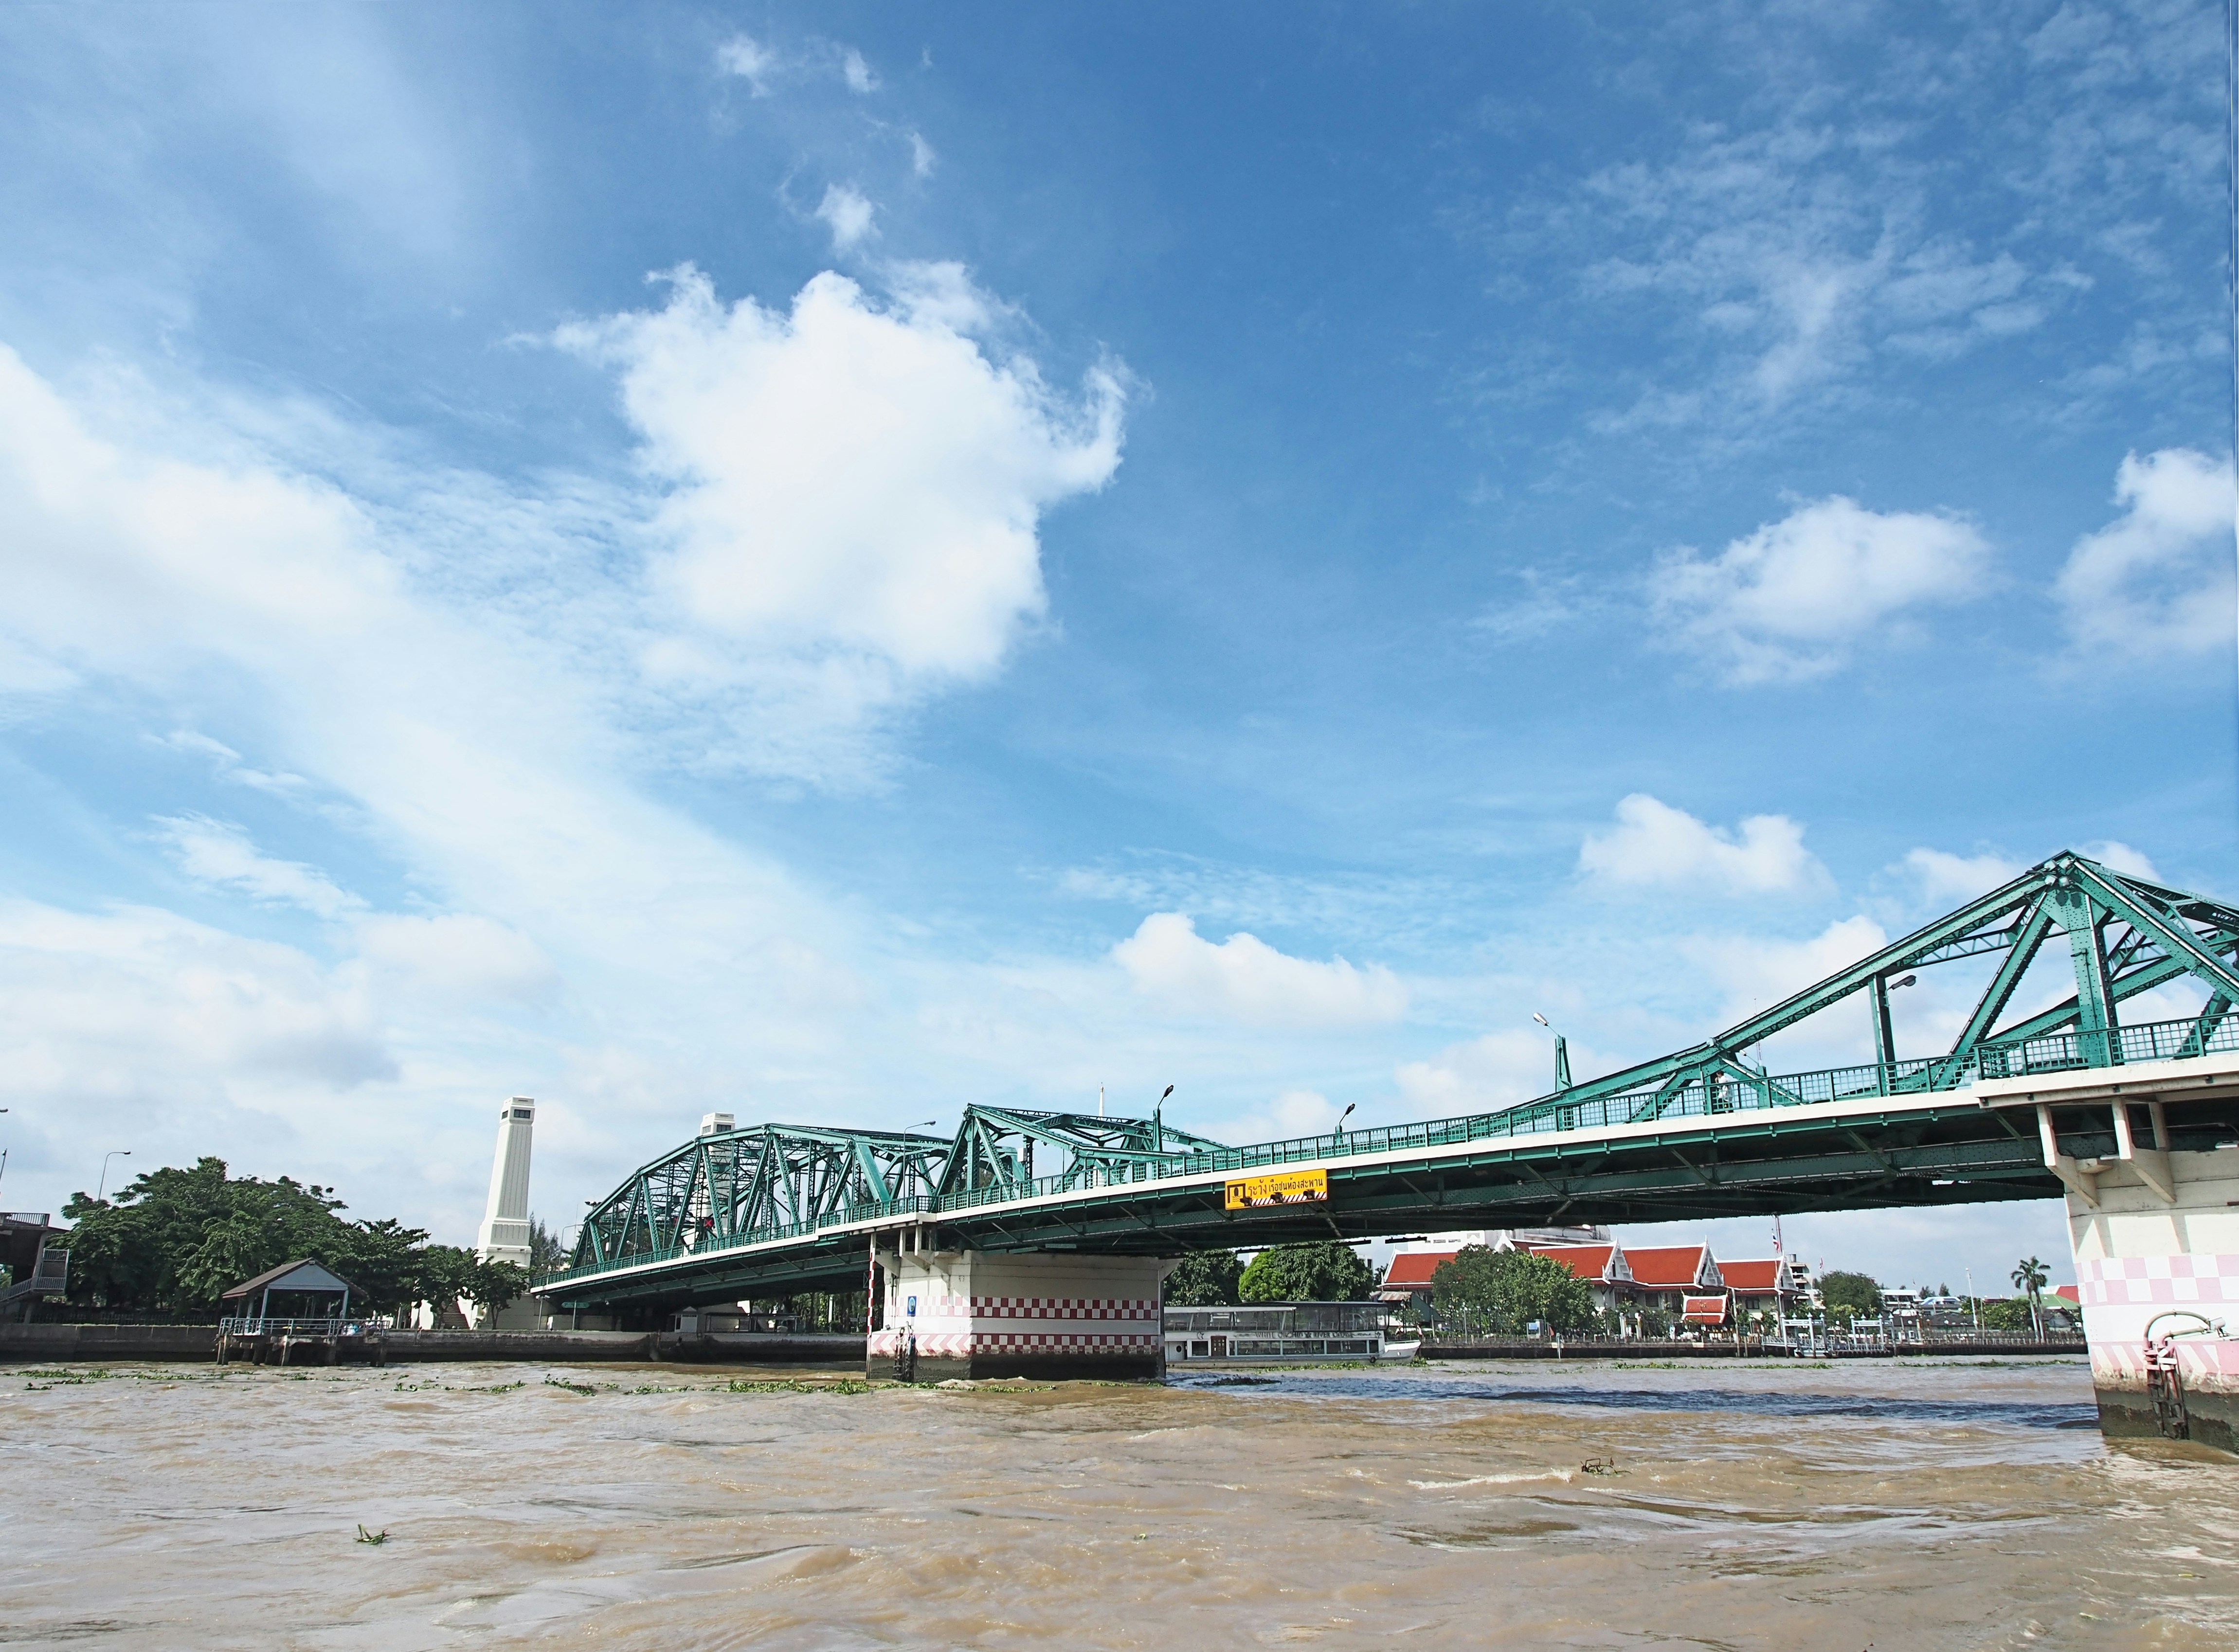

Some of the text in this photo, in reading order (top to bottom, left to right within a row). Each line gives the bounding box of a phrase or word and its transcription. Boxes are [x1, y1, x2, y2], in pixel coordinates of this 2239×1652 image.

[1248, 1177, 1323, 1197] ระวัง เรือชนท้องสะพาน
